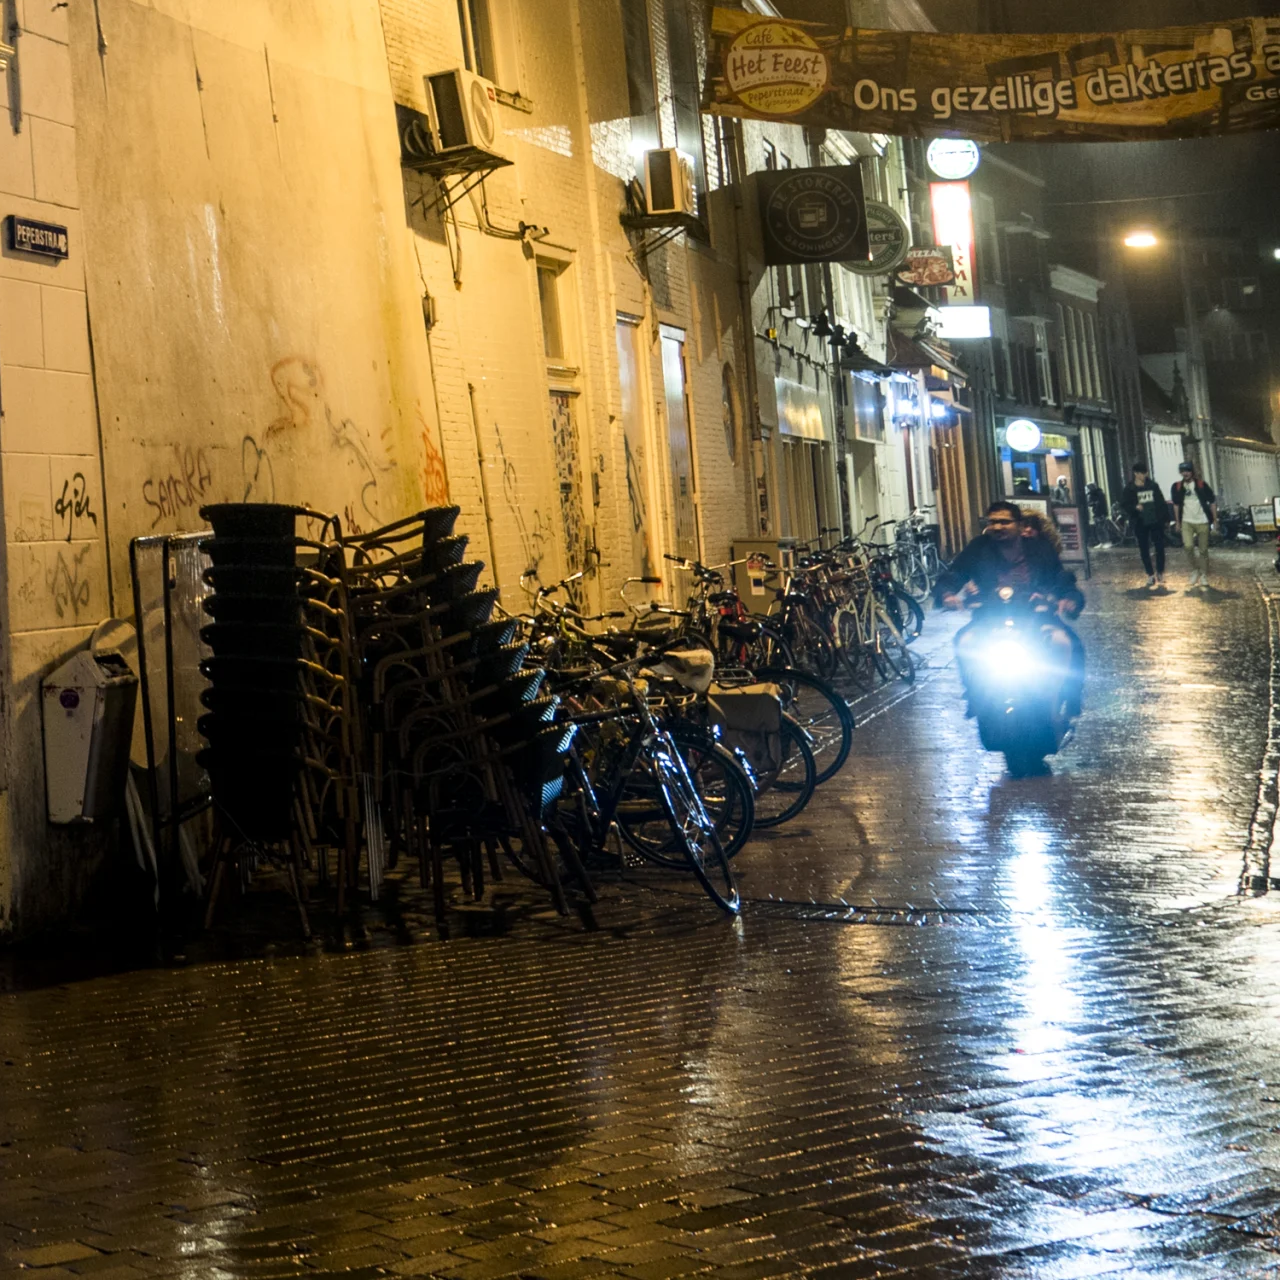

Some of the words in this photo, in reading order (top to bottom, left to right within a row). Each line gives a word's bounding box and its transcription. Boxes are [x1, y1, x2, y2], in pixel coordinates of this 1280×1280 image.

[745, 28, 773, 45] Café
[732, 51, 767, 80] Het
[772, 53, 822, 76] Feest
[748, 86, 804, 104] Peperstraat
[853, 78, 917, 112] Ons
[931, 75, 1075, 119] gezellige
[1086, 50, 1252, 103] dakterras
[787, 175, 852, 207] STOKERIJ
